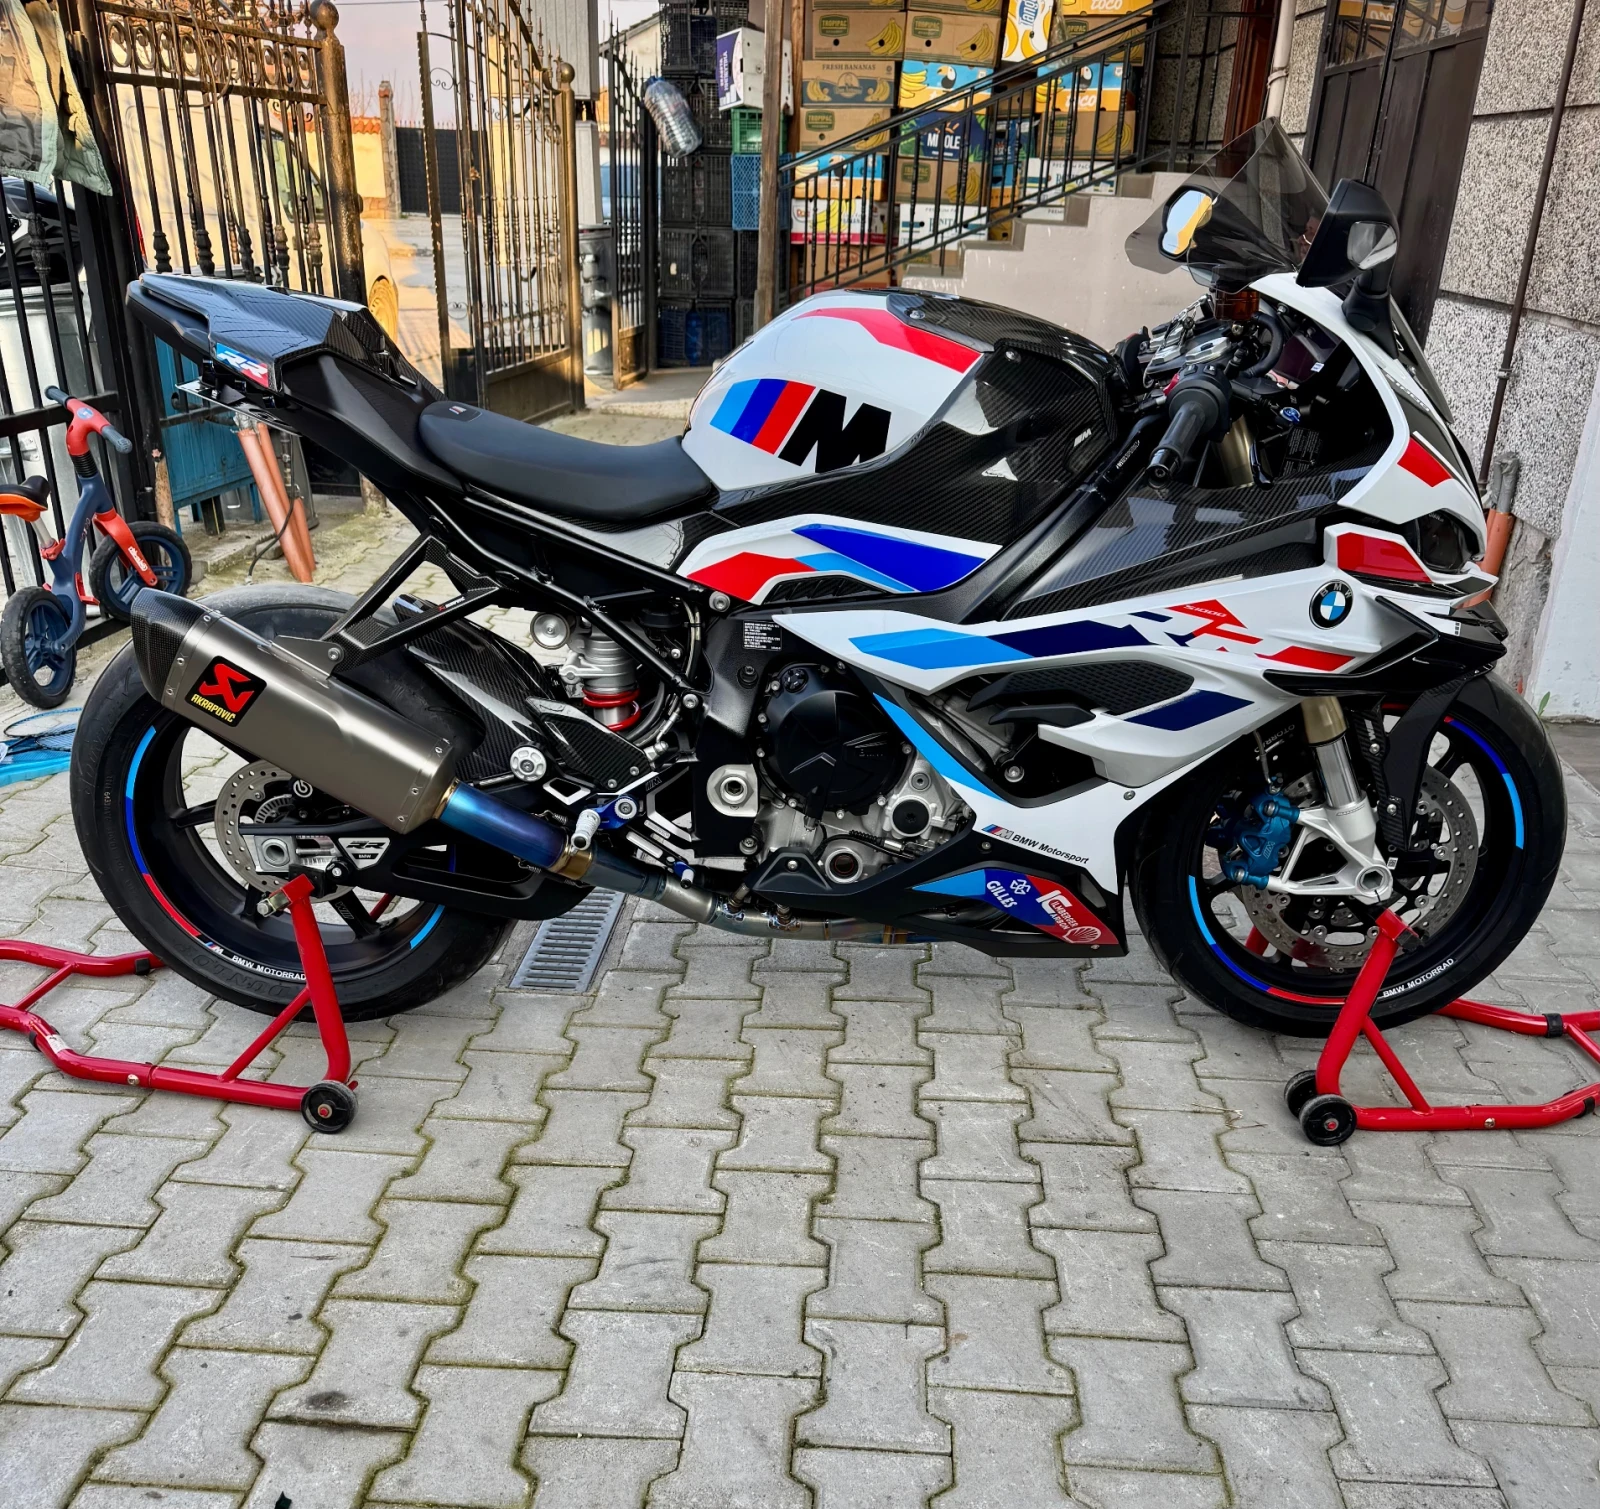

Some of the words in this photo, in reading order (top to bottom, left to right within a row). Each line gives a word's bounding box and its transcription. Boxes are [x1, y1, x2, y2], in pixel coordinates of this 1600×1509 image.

[821, 19, 847, 27] TROPIPAC
[1019, 0, 1038, 25] Tang
[808, 114, 832, 122] TROPIPAC
[778, 388, 892, 474] M
[1320, 582, 1353, 599] BMW
[190, 693, 236, 723] AKRAPOVIC
[1012, 834, 1039, 848] BMW
[1038, 843, 1089, 865] Motorsport
[986, 880, 1018, 908] GILLES
[231, 954, 255, 969] BMW
[256, 964, 307, 981] MOTORRAD
[1382, 984, 1405, 998] BMW
[1407, 958, 1454, 989] MOTORRAD
